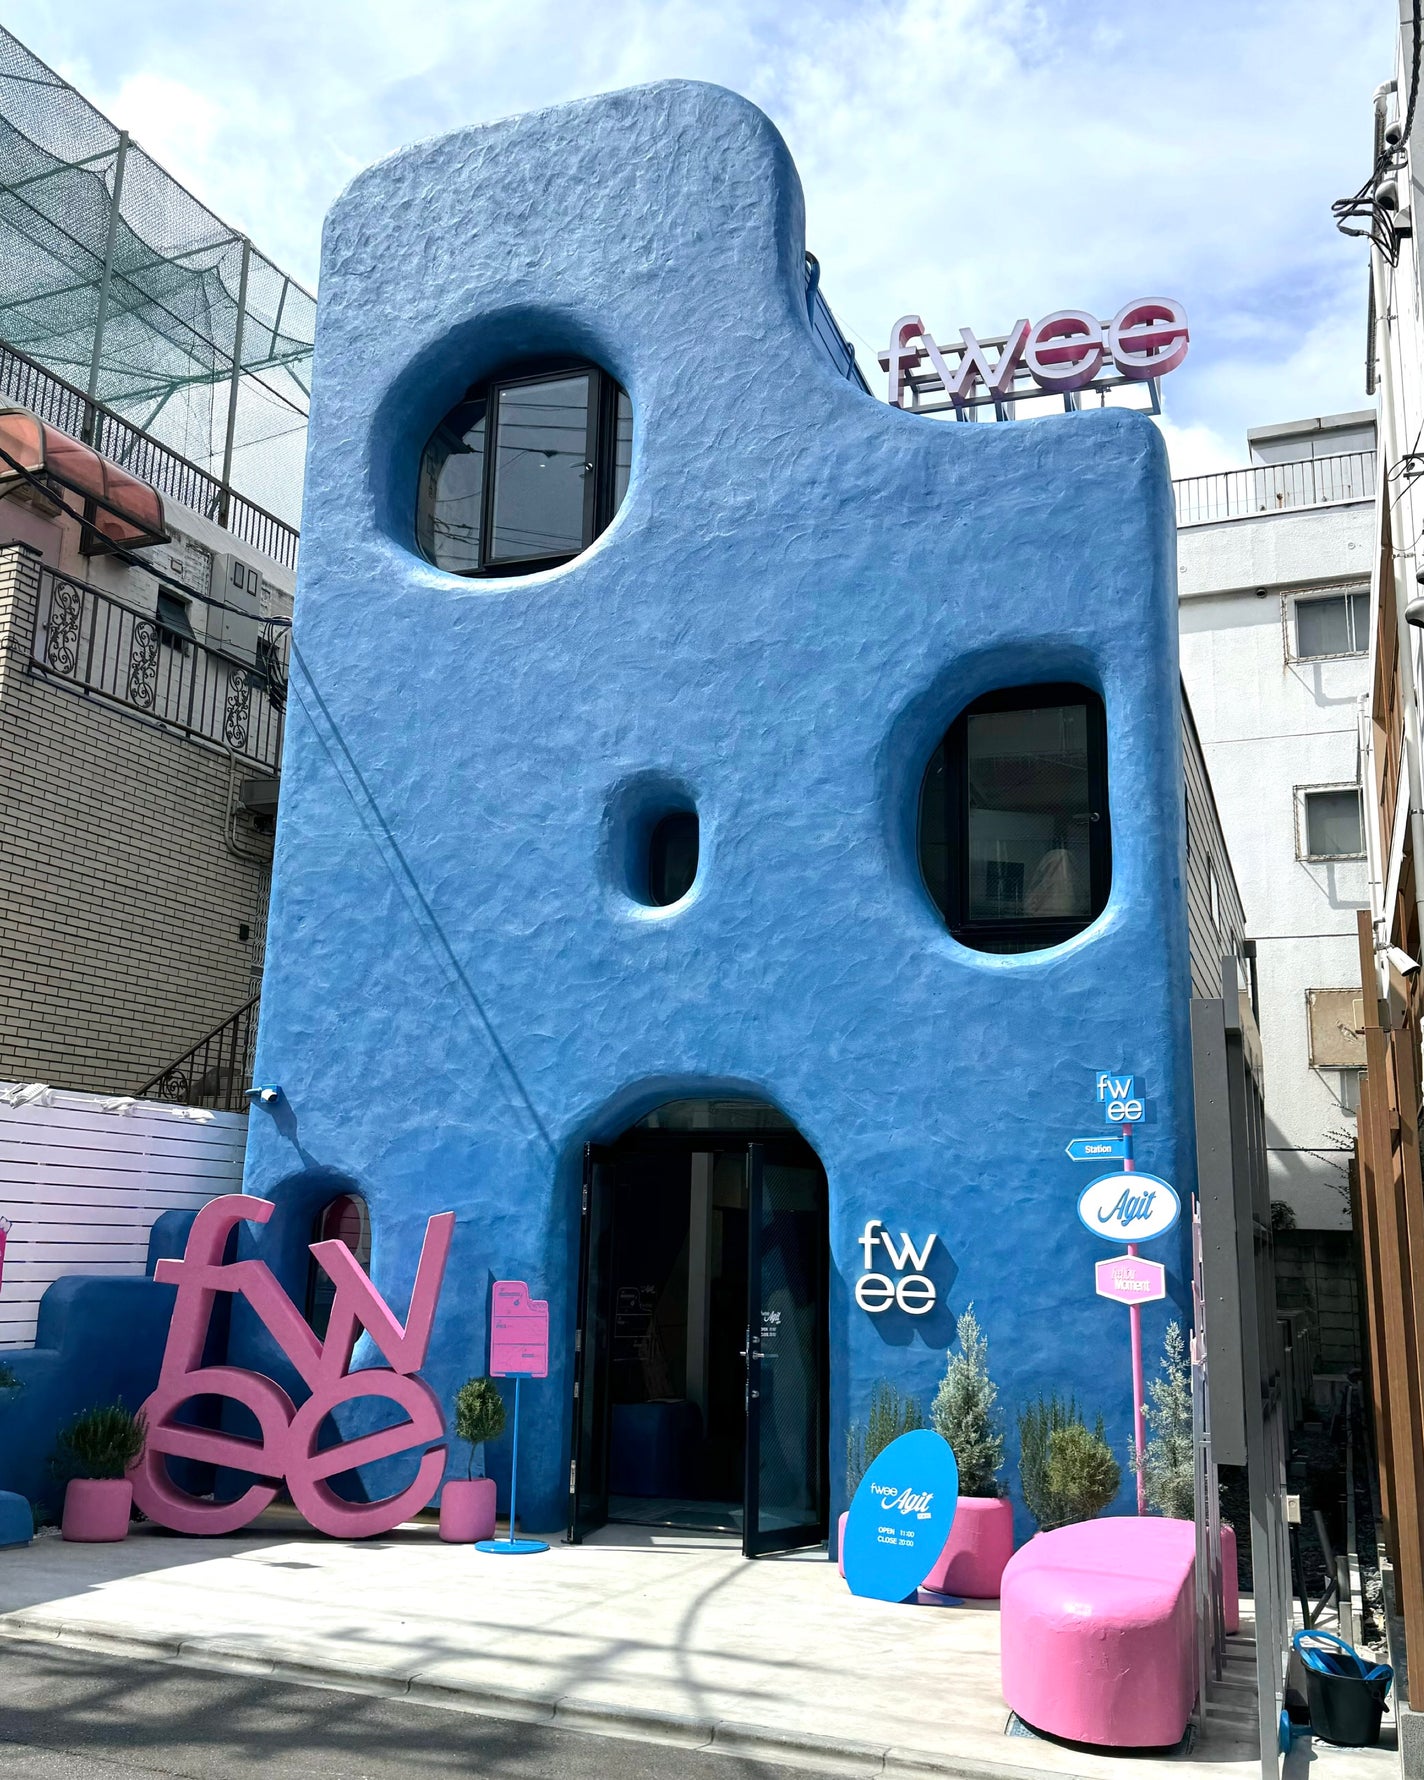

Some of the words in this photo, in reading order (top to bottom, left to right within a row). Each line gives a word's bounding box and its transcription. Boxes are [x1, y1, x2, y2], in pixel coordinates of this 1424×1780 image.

[878, 297, 1190, 407] fwee
[1097, 1074, 1132, 1100] fw
[1108, 1099, 1142, 1121] ee
[1084, 1144, 1112, 1154] Station
[1098, 1188, 1156, 1226] Agit
[858, 1219, 937, 1271] fw
[153, 1193, 456, 1392] fw
[855, 1273, 936, 1315] ee
[1114, 1279, 1151, 1292] Moment
[124, 1366, 448, 1538] ee
[870, 1482, 898, 1496] fwee
[881, 1487, 934, 1515] Agit
[877, 1536, 897, 1544] CLOSE
[878, 1526, 895, 1535] OPEN
